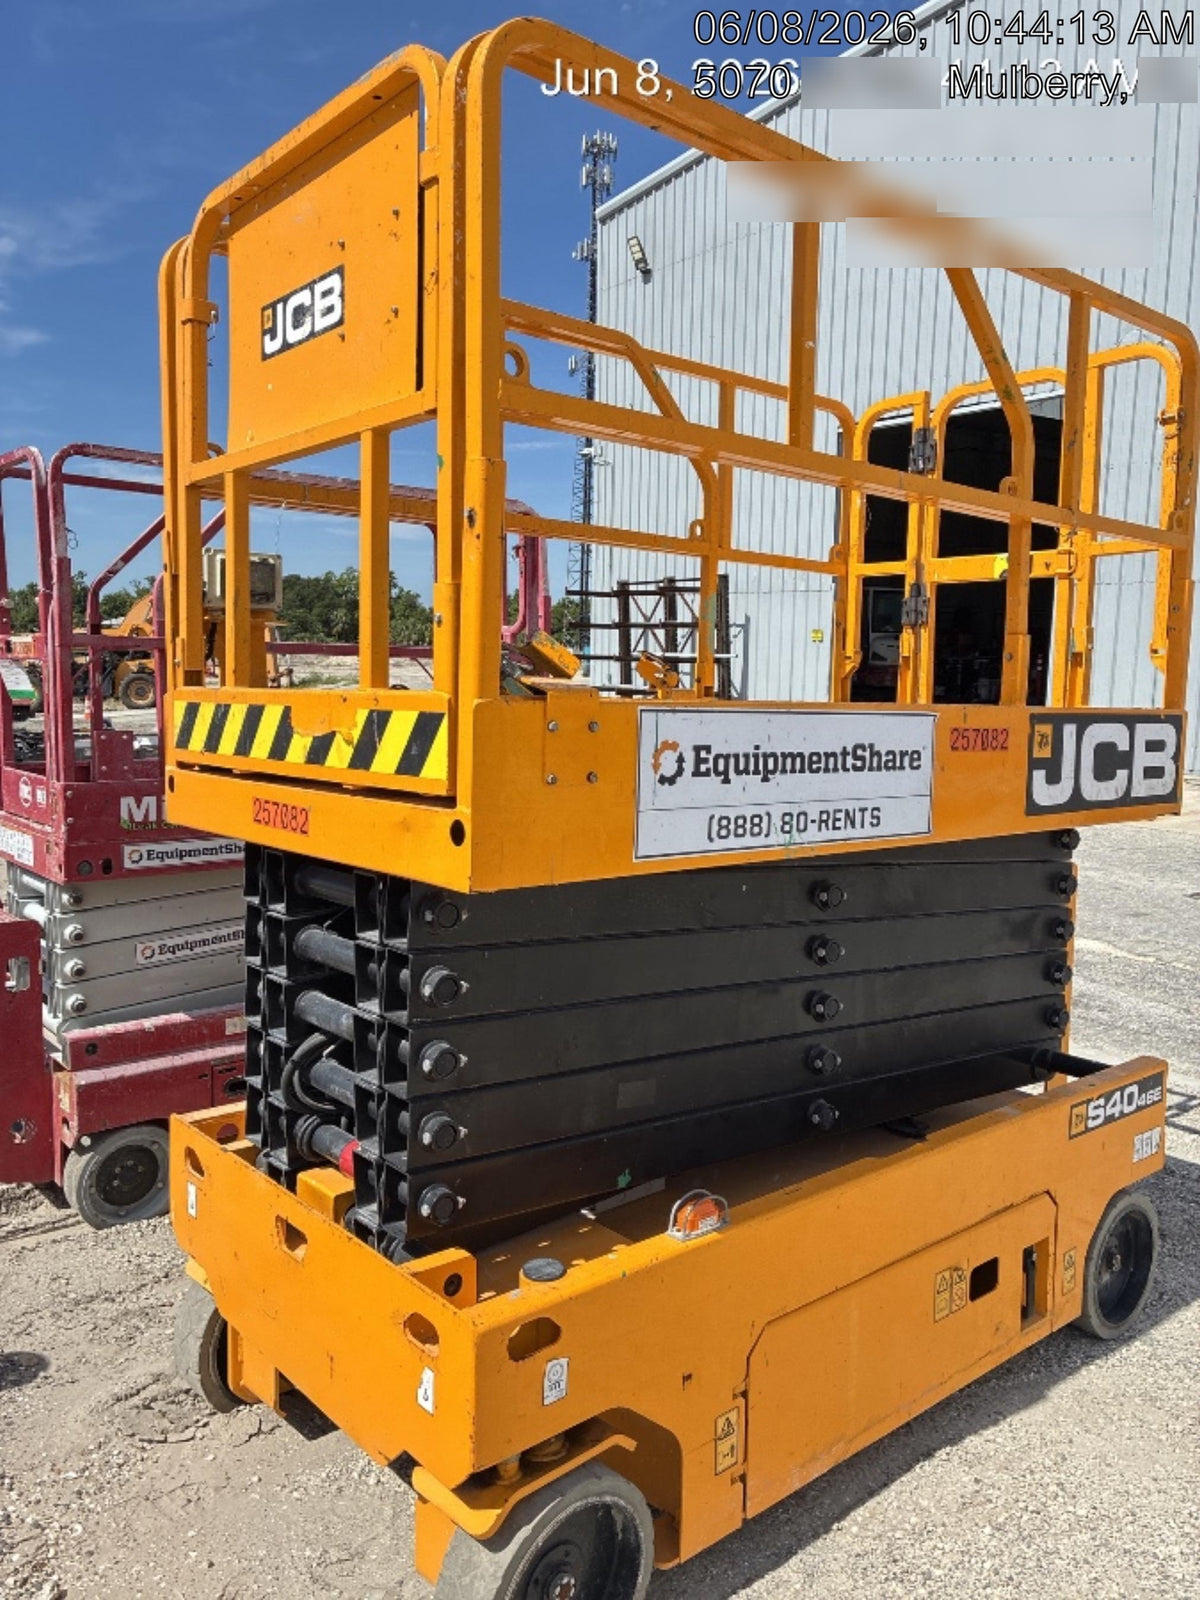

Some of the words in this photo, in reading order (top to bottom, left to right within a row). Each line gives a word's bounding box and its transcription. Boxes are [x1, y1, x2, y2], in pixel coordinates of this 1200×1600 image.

[263, 273, 342, 355] JCB
[951, 728, 1009, 750] 257082
[691, 743, 922, 784] EquipmentShare
[1032, 723, 1177, 806] JCB
[253, 798, 308, 834] 257082
[707, 812, 772, 842] (888)
[780, 807, 881, 835] 80-RENTS
